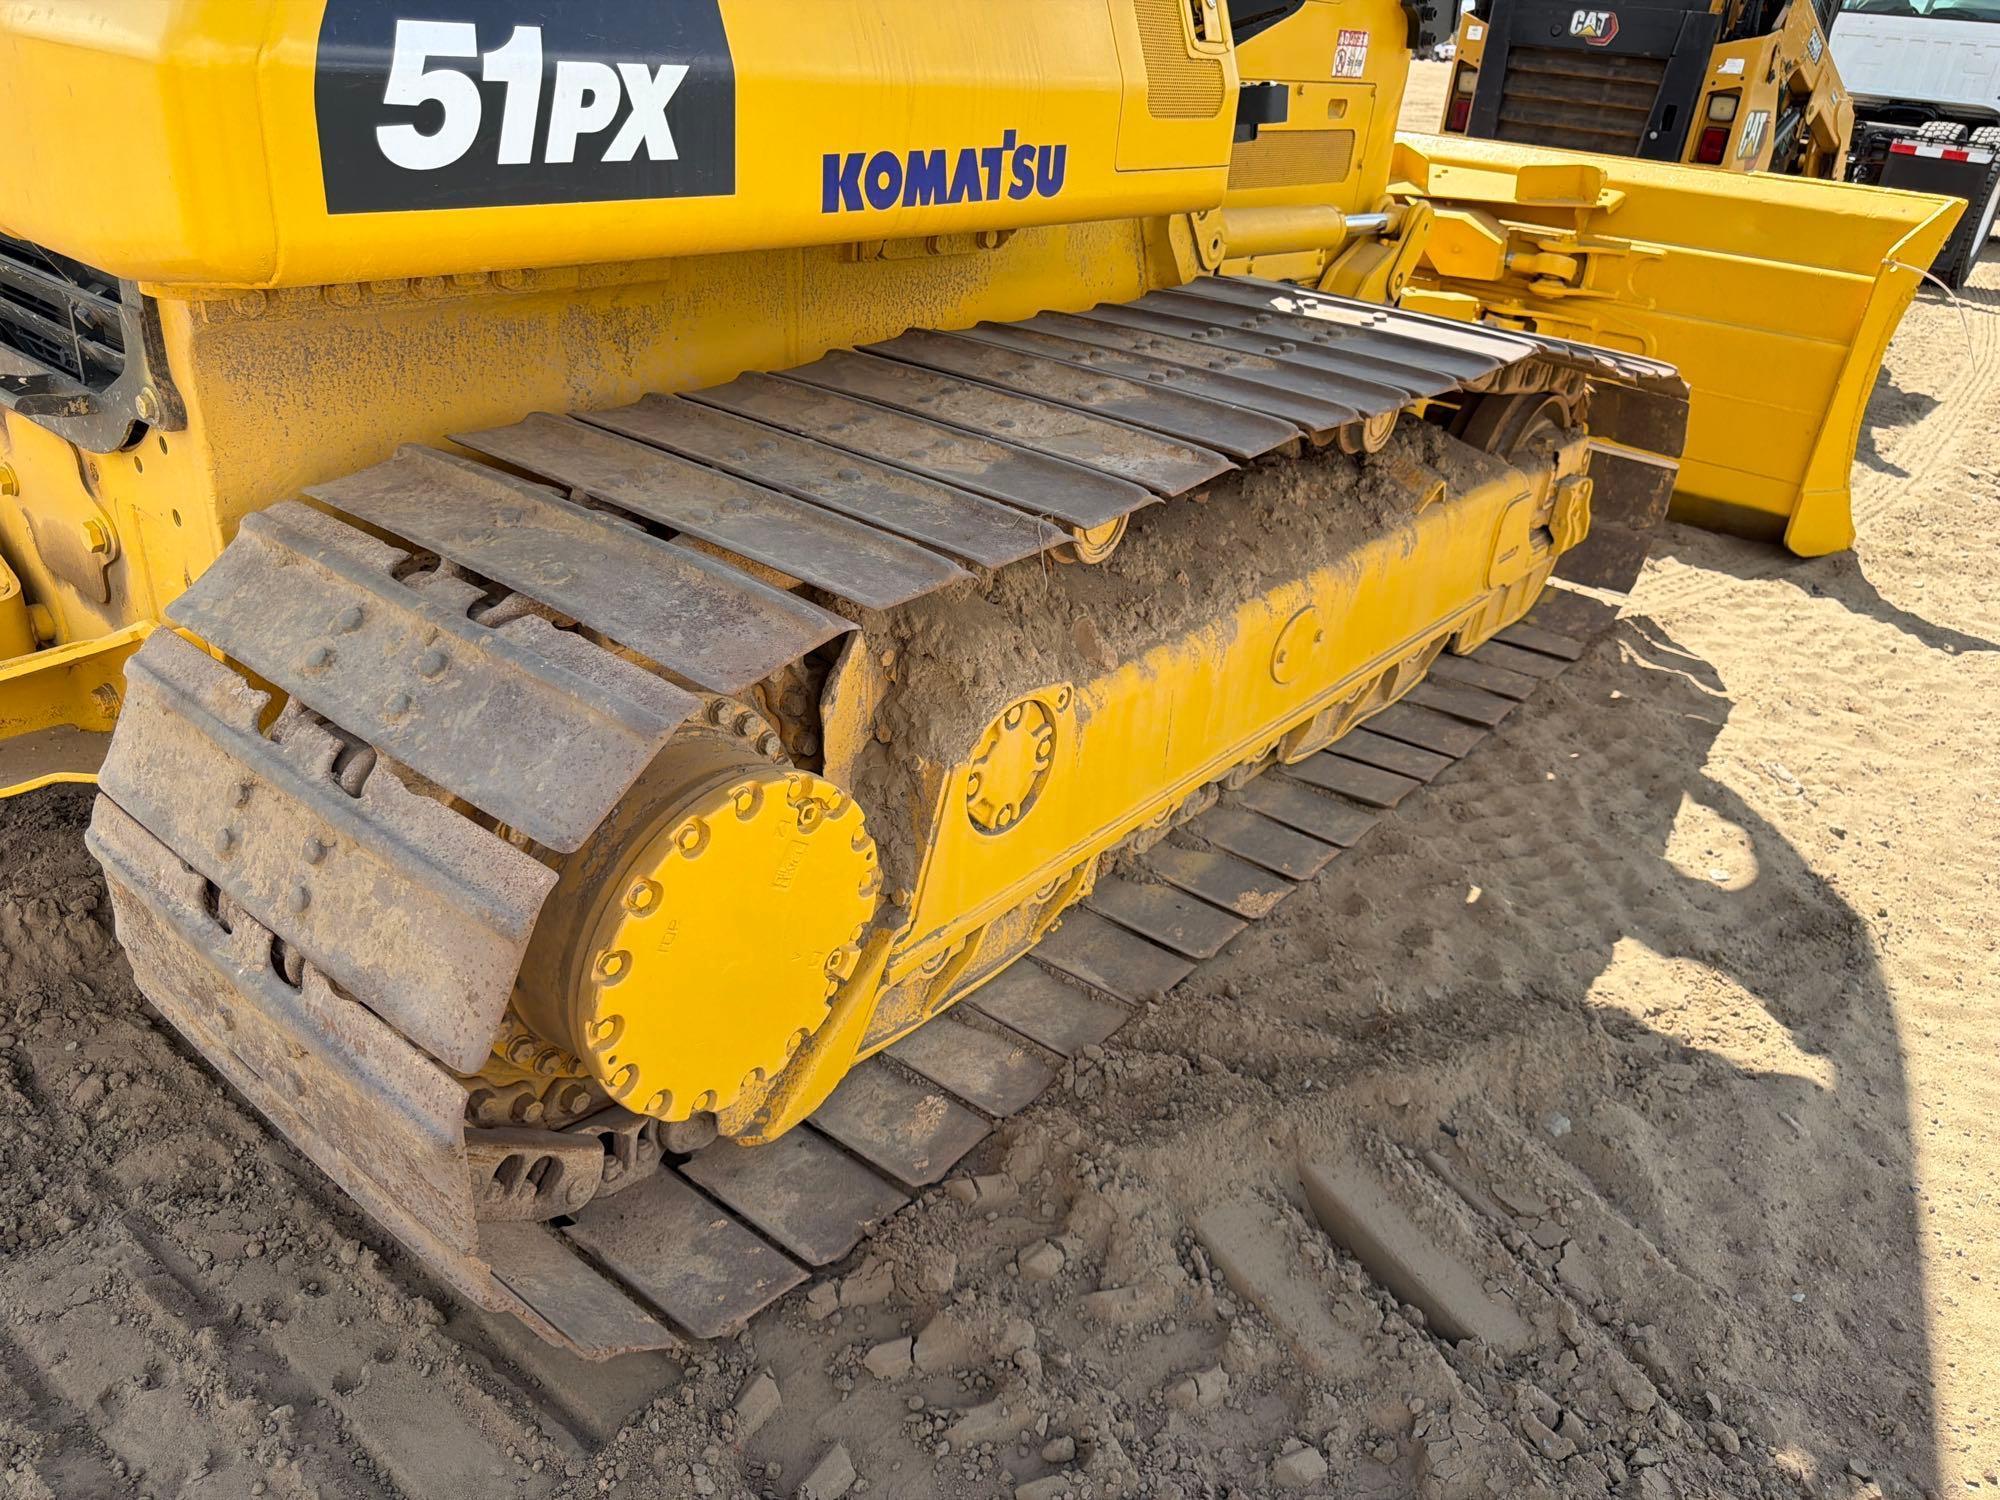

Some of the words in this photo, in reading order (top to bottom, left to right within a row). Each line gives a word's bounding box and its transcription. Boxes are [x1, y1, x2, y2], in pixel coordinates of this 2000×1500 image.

[1570, 10, 1609, 37] CAT
[376, 20, 690, 170] 51PX
[1738, 112, 1768, 158] CAT
[821, 129, 1067, 213] KOMATSU
